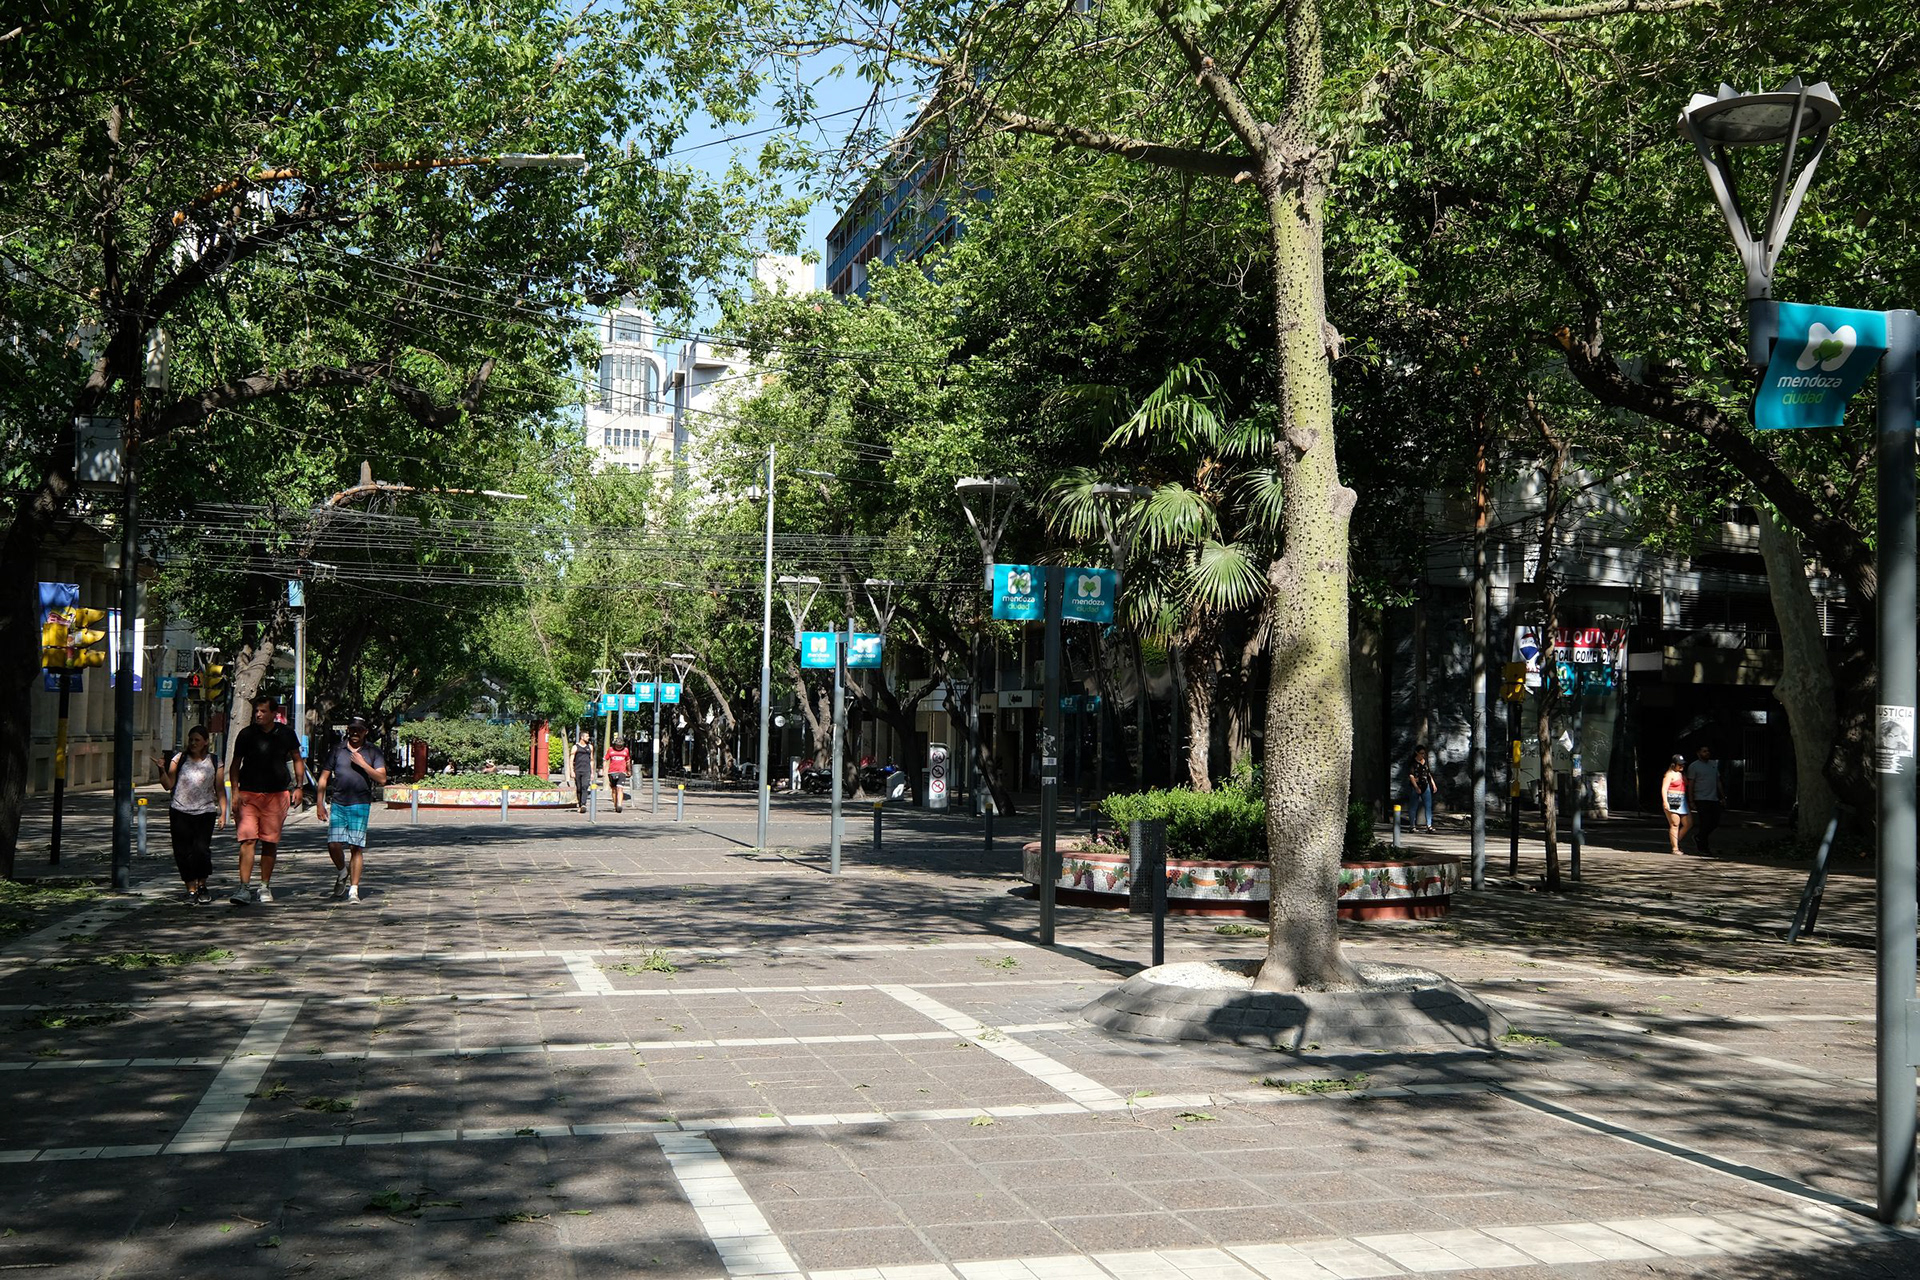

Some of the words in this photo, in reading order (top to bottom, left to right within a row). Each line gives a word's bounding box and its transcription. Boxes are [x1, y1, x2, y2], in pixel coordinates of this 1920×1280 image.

[1777, 374, 1842, 388] mendoza
[1782, 390, 1825, 404] ciudad
[1002, 595, 1036, 603] mendoza
[1071, 598, 1105, 606] mendoza
[1007, 602, 1030, 611] ciudad
[1076, 605, 1100, 613] ciudad
